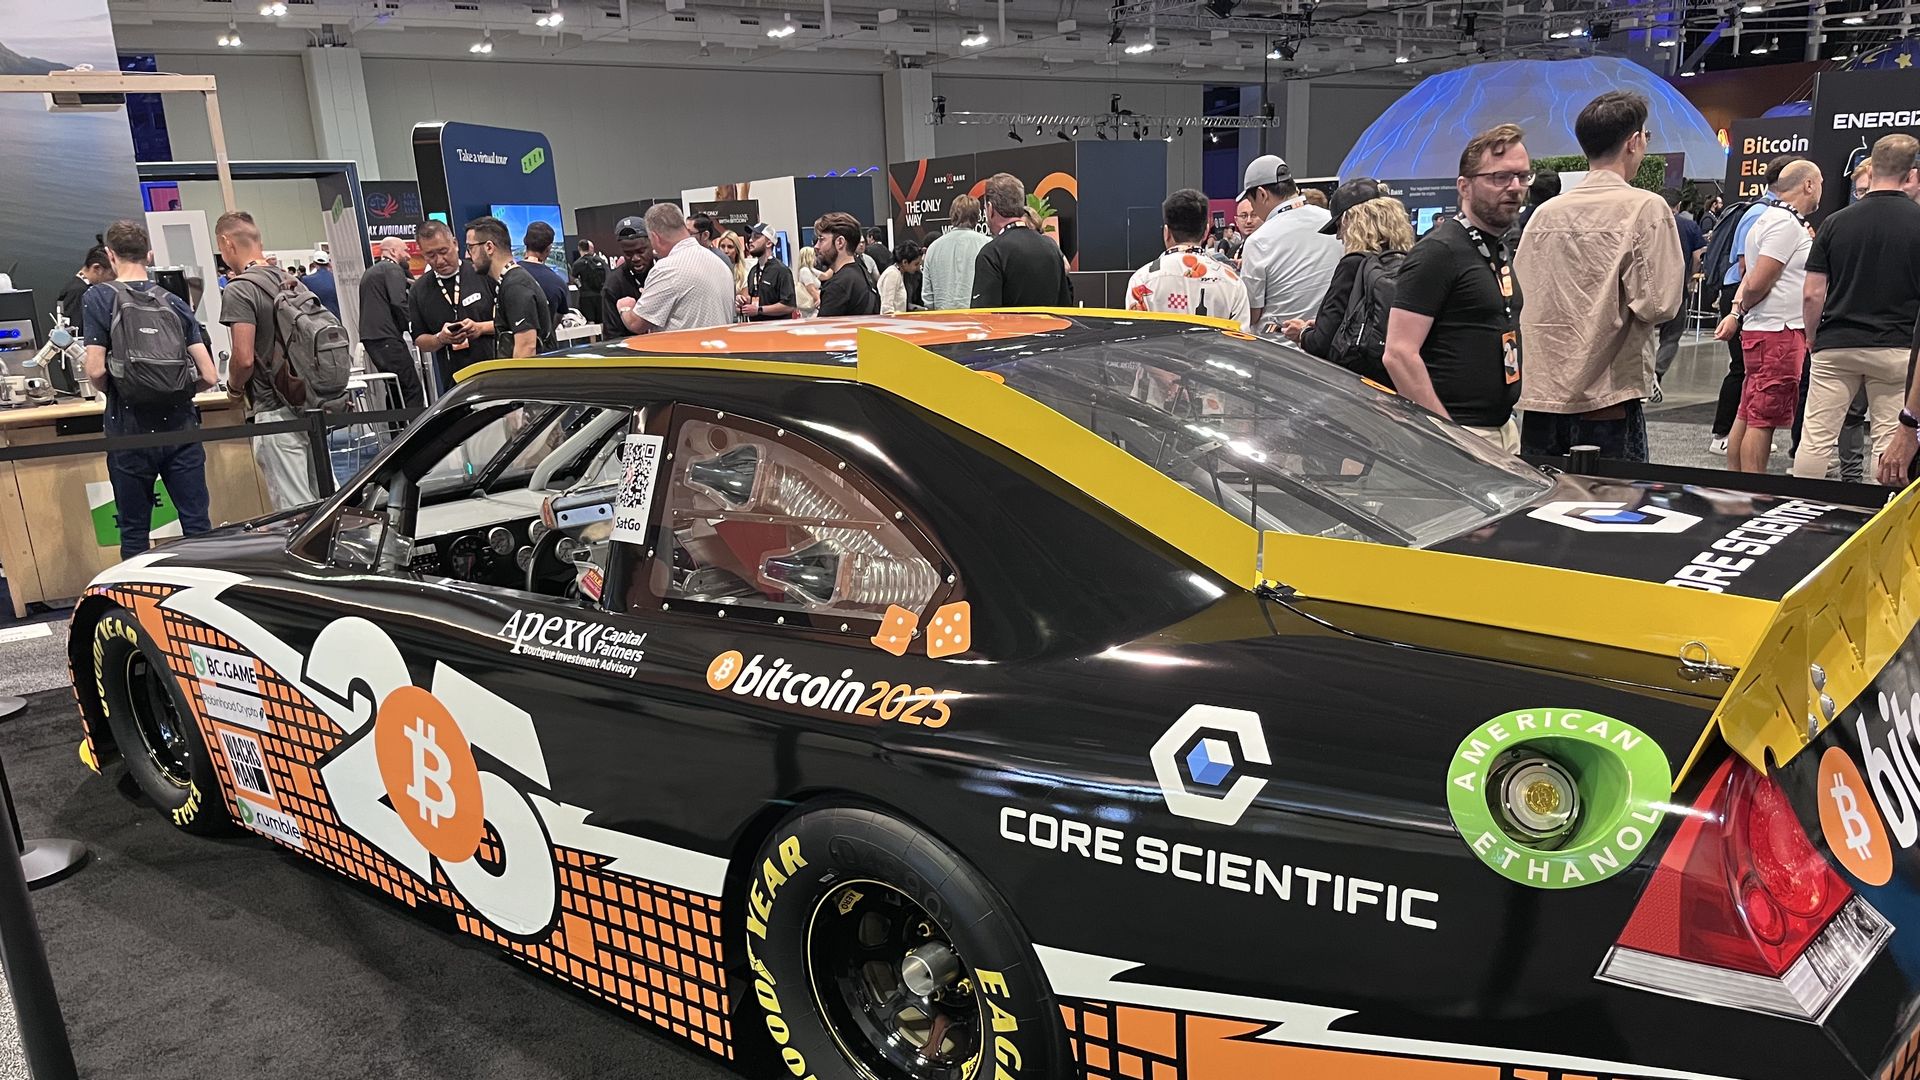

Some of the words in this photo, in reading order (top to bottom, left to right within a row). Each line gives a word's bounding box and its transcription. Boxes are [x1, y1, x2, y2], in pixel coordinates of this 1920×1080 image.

[456, 149, 473, 162] Take
[1743, 134, 1809, 154] Bitcoin
[1741, 159, 1768, 176] Ela
[905, 201, 921, 214] THE
[921, 199, 941, 213] ONLY
[906, 214, 923, 227] WAY
[368, 226, 377, 235] AX
[379, 225, 416, 235] AVOIDANCE
[616, 517, 641, 531] SatGo
[497, 609, 586, 655] Apex
[601, 627, 647, 646] Capital
[522, 644, 555, 660] Boutique
[555, 651, 600, 668] Investment
[600, 659, 638, 678] Advisory
[593, 640, 644, 662] Partners
[732, 654, 865, 714] bitcoin
[855, 681, 962, 729] 2025
[222, 732, 262, 768] WACHS
[1453, 711, 1643, 792] AMERICAN
[231, 759, 261, 792] MAN
[172, 779, 202, 826] EAGLE
[257, 812, 301, 839] rumble
[1473, 800, 1662, 884] ETHANOL
[1000, 806, 1125, 865] CORE
[1135, 836, 1439, 930] SCIENTIFIC
[746, 835, 809, 1080] OODYEAR
[974, 967, 1022, 1080] EAG
